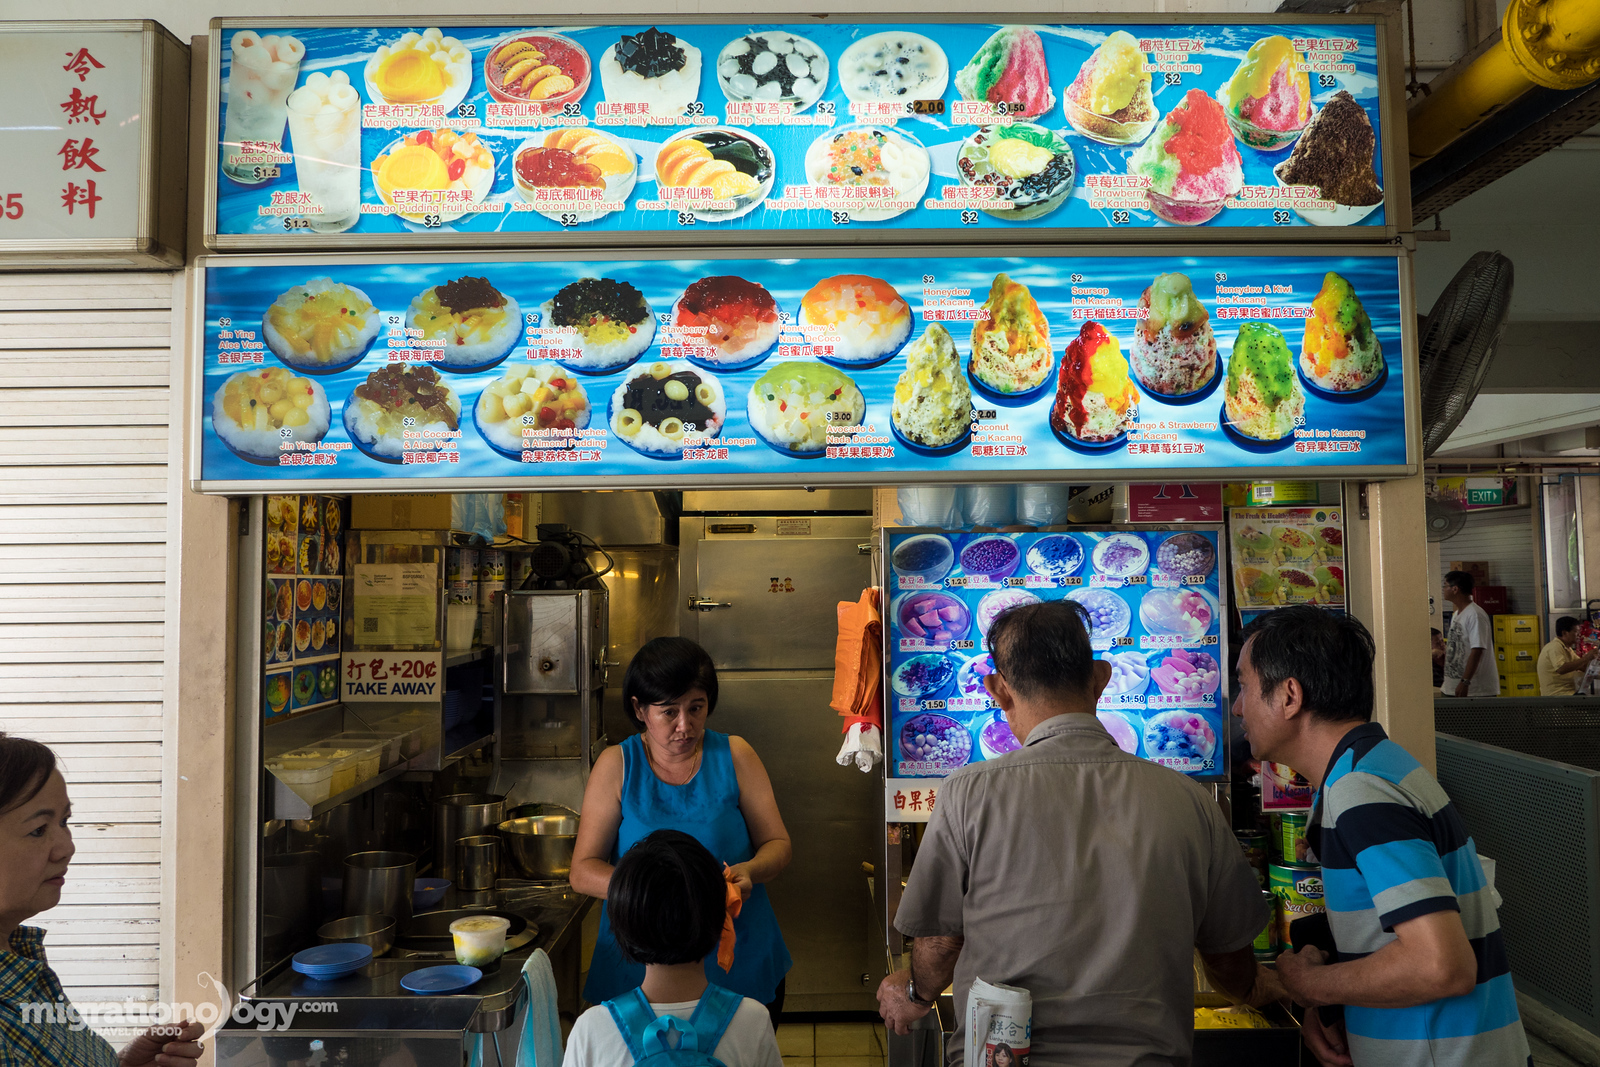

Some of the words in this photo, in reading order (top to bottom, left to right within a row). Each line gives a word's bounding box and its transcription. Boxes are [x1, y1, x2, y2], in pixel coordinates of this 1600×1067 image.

[1293, 39, 1358, 51] 芒果红豆冰
[1156, 52, 1188, 61] Durian
[1309, 52, 1342, 62] Mango
[1319, 74, 1334, 86] $2
[364, 105, 445, 117] 芒果布丁龙眼
[487, 104, 541, 116] 草莓仙桃
[687, 103, 703, 114] $2
[953, 102, 992, 114] 红豆冰
[364, 118, 398, 128] Mango
[401, 118, 442, 128] Pudding
[444, 118, 480, 128] Longan
[486, 117, 539, 127] Strawberry
[542, 118, 554, 126] De
[557, 117, 587, 126] Peach
[596, 116, 624, 124] Grass
[627, 116, 648, 126] Jelly
[651, 116, 674, 124] Nata
[677, 116, 690, 124] De
[692, 116, 718, 124] Coco
[727, 115, 753, 126] Attap
[756, 115, 780, 124] Seed
[783, 115, 810, 124] Grass
[813, 115, 835, 126] Jelly
[857, 115, 896, 125] Soursop
[953, 115, 965, 123] Ice
[967, 115, 1011, 126] Kachang
[57, 48, 107, 219] 冷熱飲料
[230, 154, 264, 165] Lychee
[266, 153, 292, 164] Drink
[1086, 176, 1152, 188] 草莓红豆冰
[392, 191, 473, 203] 芒果布丁杂果
[659, 187, 713, 199] 仙草仙桃
[1094, 188, 1145, 199] Strawberry
[1241, 186, 1320, 199] 巧克力红豆冰
[271, 192, 311, 205] 龙眼水
[926, 200, 964, 208] Chendol
[967, 199, 1014, 208] w/Durian
[361, 204, 397, 214] Mango
[399, 204, 439, 214] Pudding
[442, 203, 463, 212] Fruit
[466, 203, 504, 212] Cocktail
[513, 202, 532, 211] Sea
[535, 202, 576, 211] Coconut
[578, 201, 591, 210] De
[594, 201, 624, 210] Peach
[637, 201, 666, 210] Grass
[668, 200, 690, 211] Jelly
[692, 200, 735, 209] w/Peach
[766, 200, 805, 209] Tadpole
[808, 200, 821, 208] De
[824, 200, 866, 209] Soursop
[868, 200, 915, 209] w/Longan
[1227, 199, 1275, 208] Chocolate
[1277, 199, 1290, 208] Ice
[1292, 199, 1336, 210] Kachang
[259, 204, 294, 216] Longan
[295, 204, 323, 215] Drink
[923, 288, 970, 297] Honeydew
[1072, 287, 1109, 296] Soursop
[1216, 286, 1262, 295] Honeydew
[940, 299, 974, 308] Kacang
[779, 312, 790, 321] $2
[556, 326, 578, 335] Jelly
[660, 325, 708, 335] Stawberry
[779, 324, 827, 334] Honeydew
[233, 331, 255, 340] Ying
[527, 337, 563, 346] Tadpole
[1127, 422, 1157, 430] Mango
[1168, 421, 1217, 430] Strawberry
[1295, 417, 1305, 425] $2
[574, 428, 606, 438] Lychee
[1331, 430, 1365, 438] Kacang
[294, 442, 316, 451] Ying
[318, 442, 352, 450] Longan
[567, 439, 606, 449] Pudding
[722, 437, 756, 446] Longan
[1295, 442, 1361, 452] 奇异果红豆冰
[683, 449, 728, 460] 红茶龙眼
[1472, 491, 1491, 501] EXIT
[347, 683, 386, 695] TAKE
[390, 683, 436, 695] AWAY
[1299, 883, 1323, 892] HOSE
[1284, 901, 1301, 912] Sea
